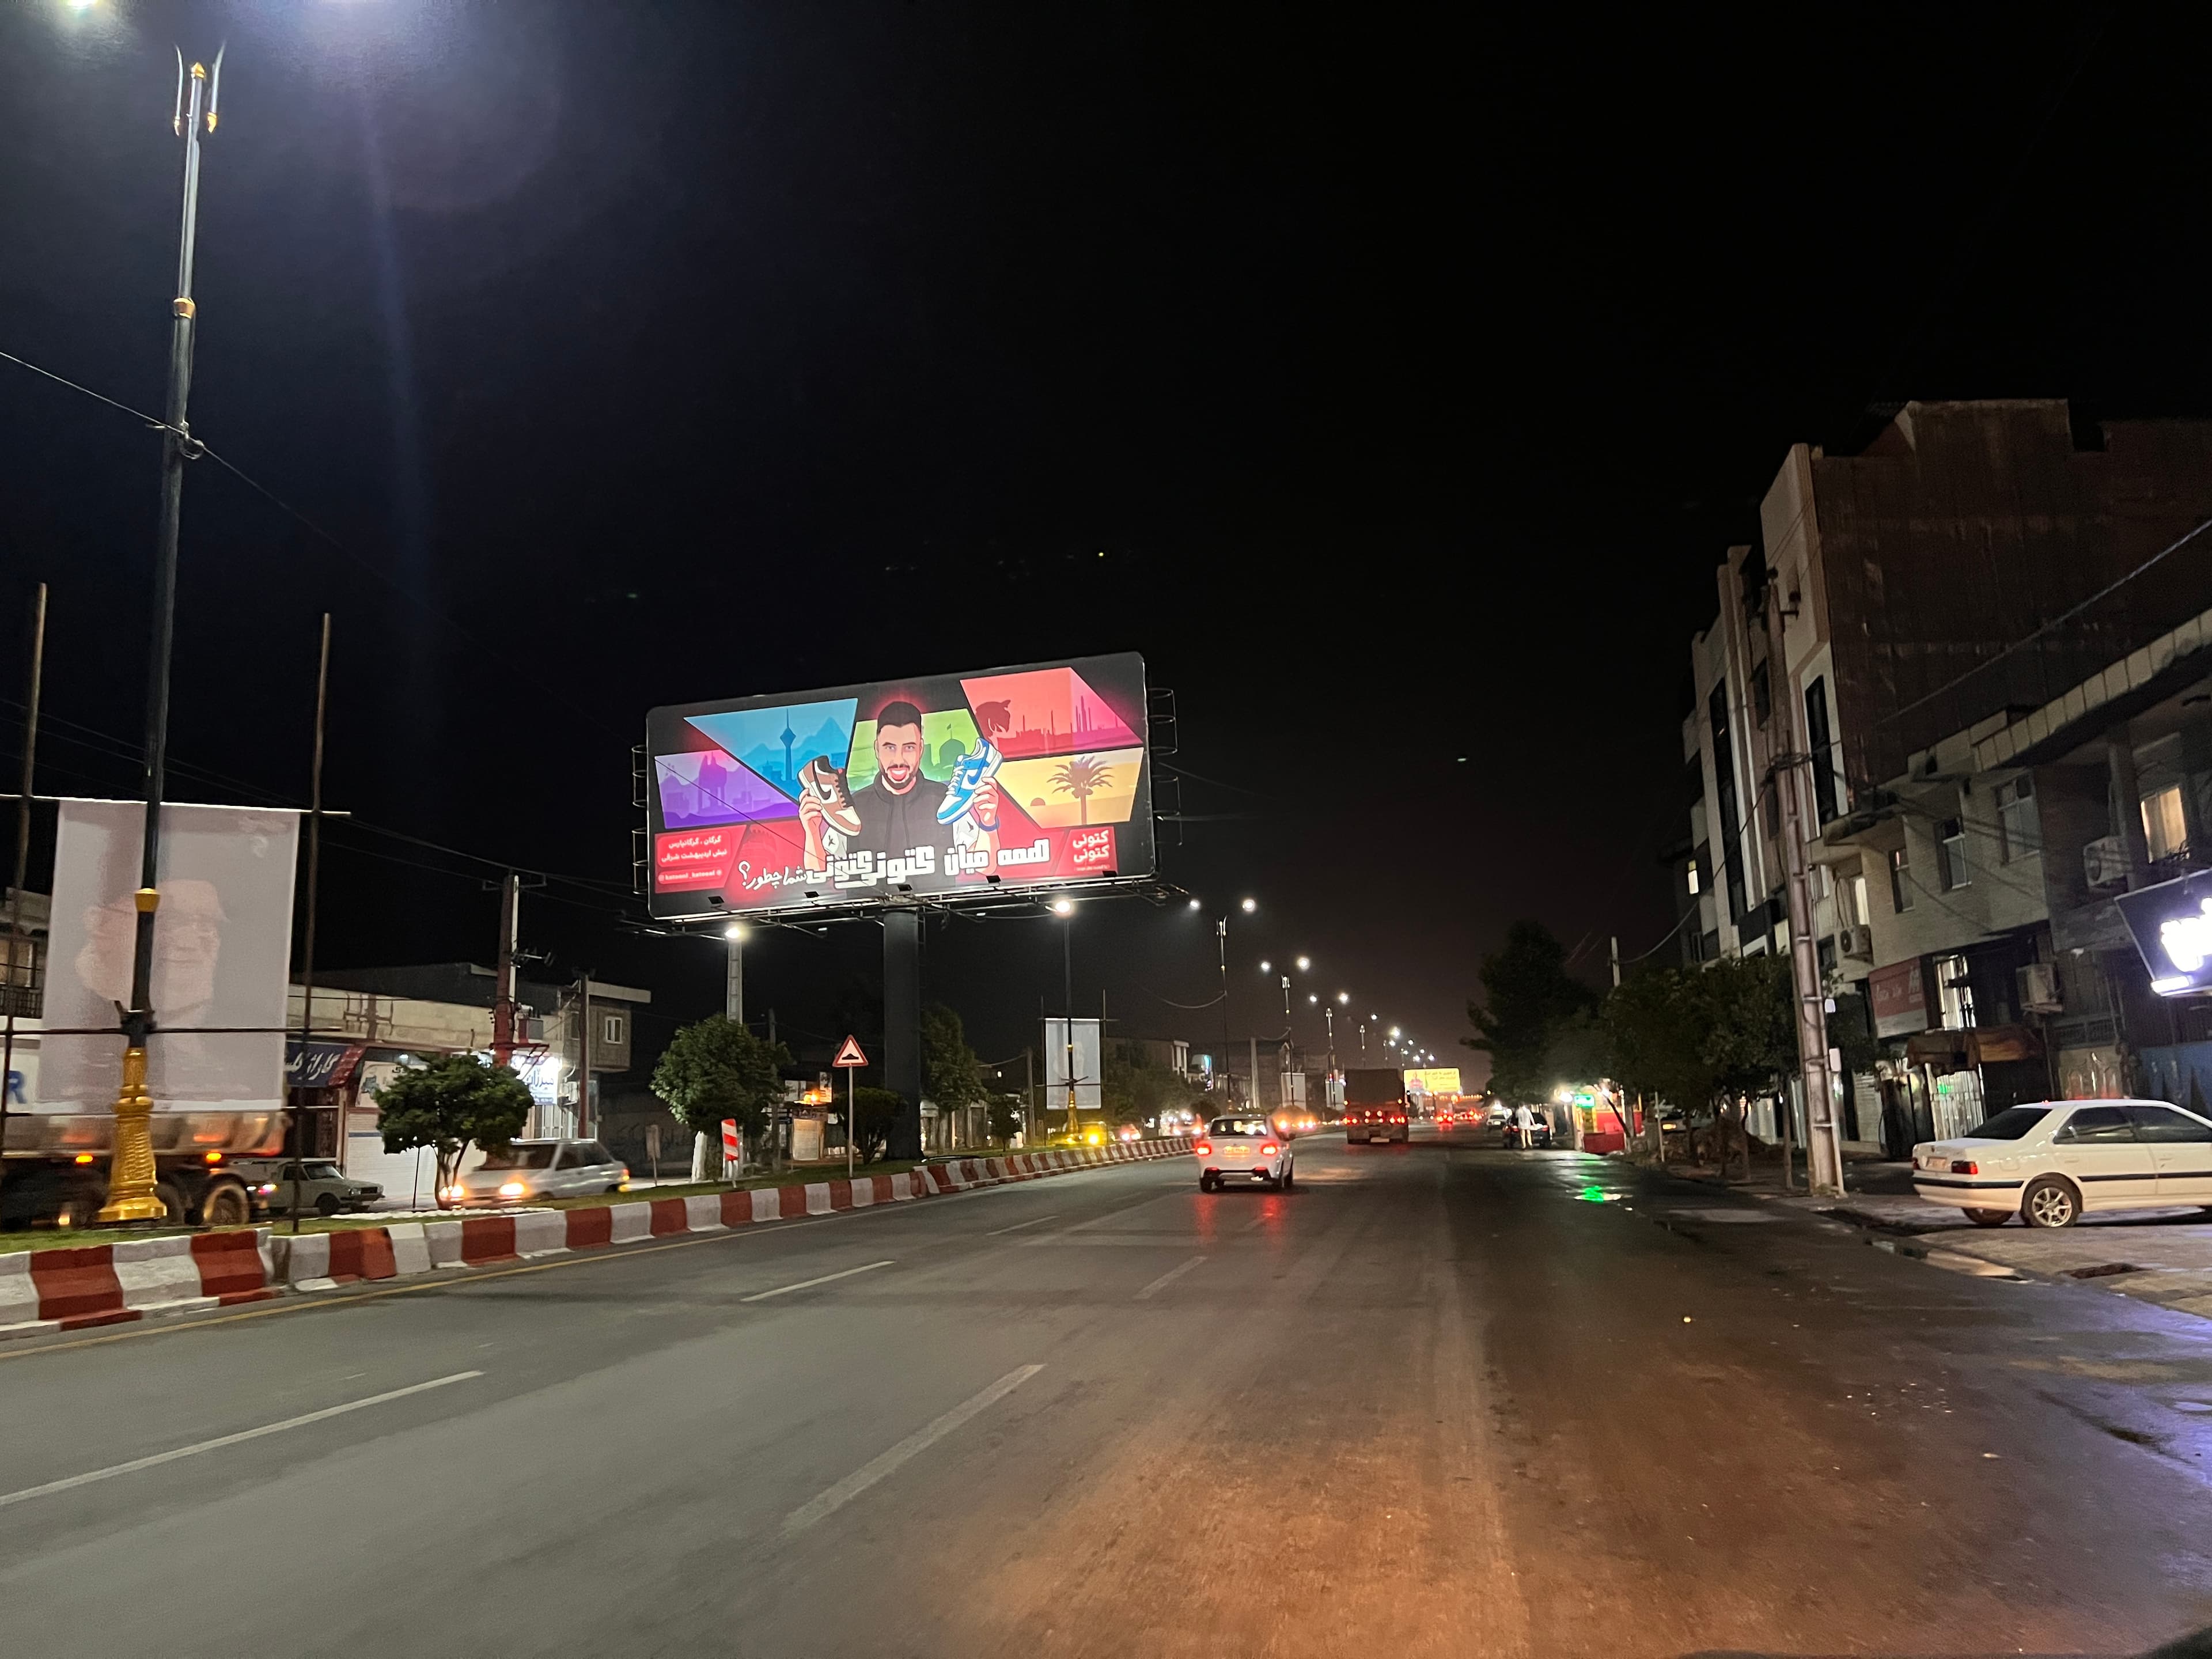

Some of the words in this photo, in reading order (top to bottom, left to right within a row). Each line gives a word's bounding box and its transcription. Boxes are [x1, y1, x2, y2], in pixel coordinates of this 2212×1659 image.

[1072, 830, 1109, 849] کتونی
[944, 844, 990, 876] میان
[997, 838, 1050, 866] همه
[1073, 844, 1110, 863] کتونی
[782, 865, 808, 886] شما
